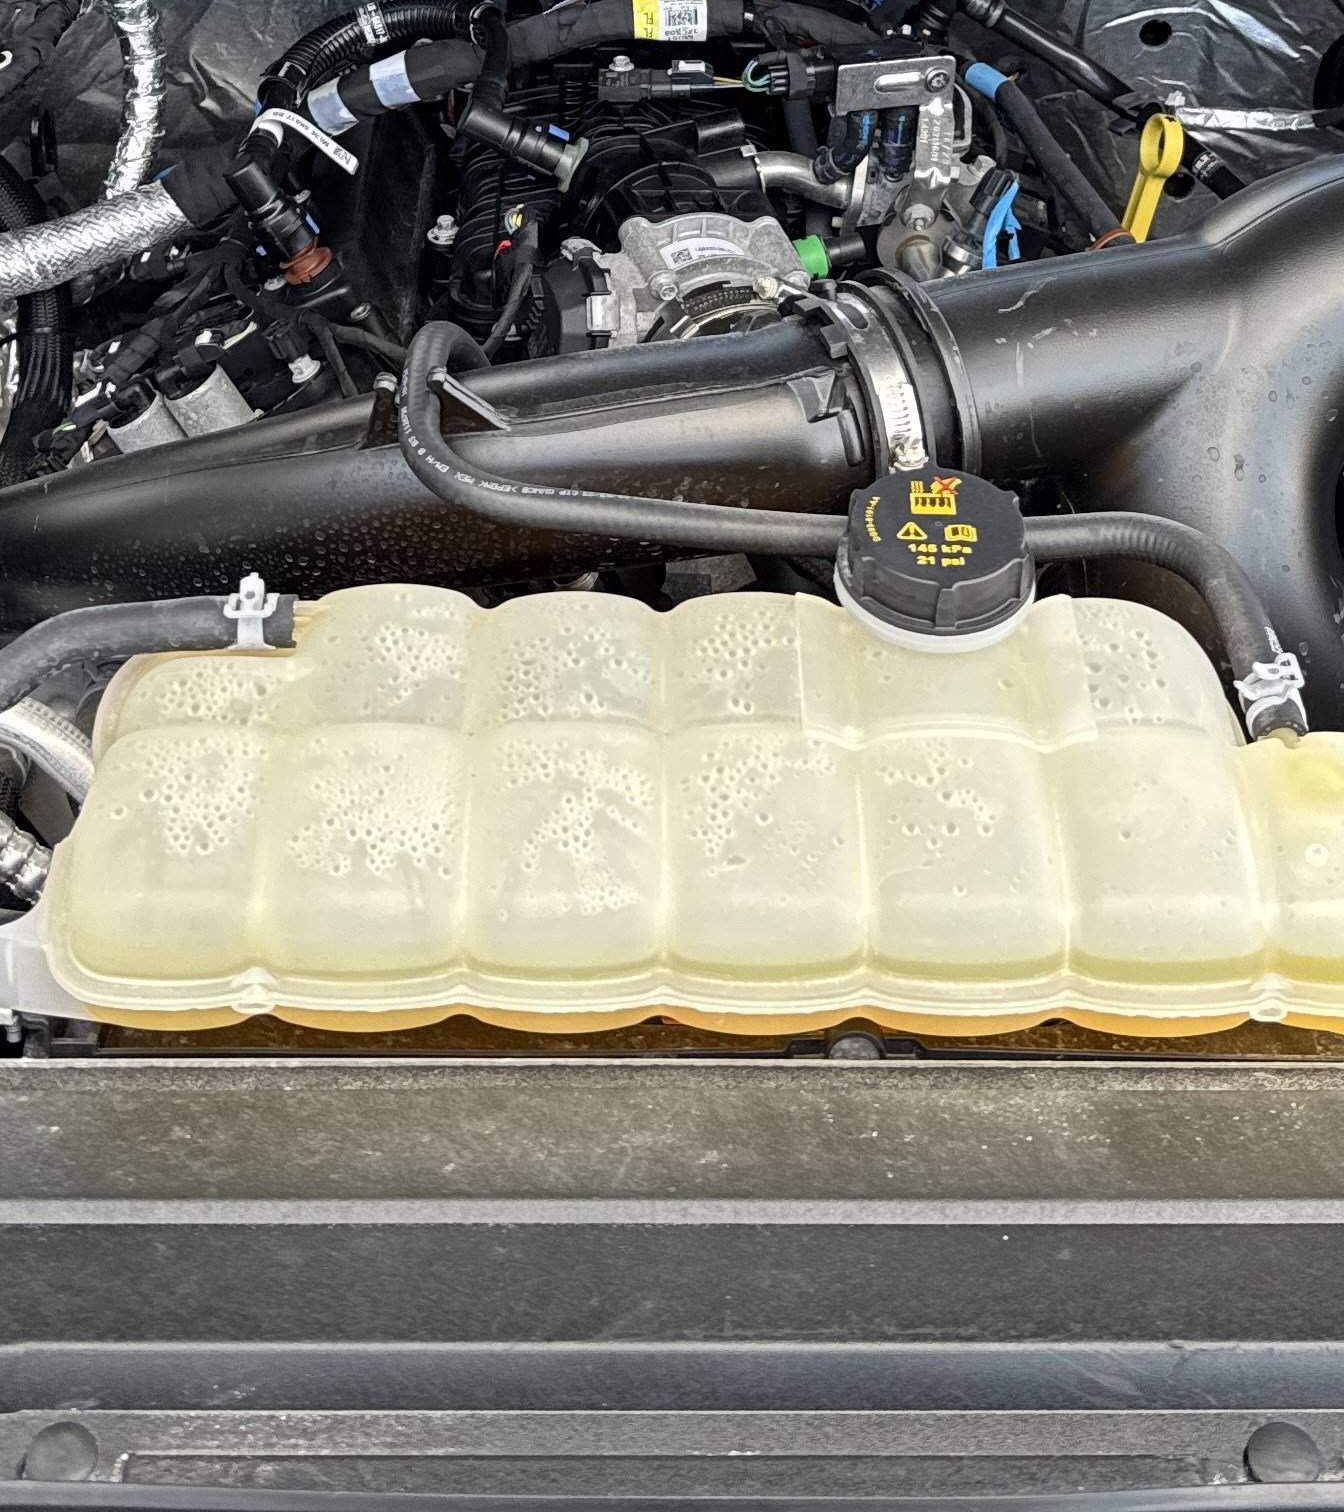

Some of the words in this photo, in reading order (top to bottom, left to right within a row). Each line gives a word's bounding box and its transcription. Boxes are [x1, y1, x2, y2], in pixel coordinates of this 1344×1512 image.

[941, 543, 972, 555] kPa
[916, 555, 936, 566] 21
[941, 556, 966, 568] psi
